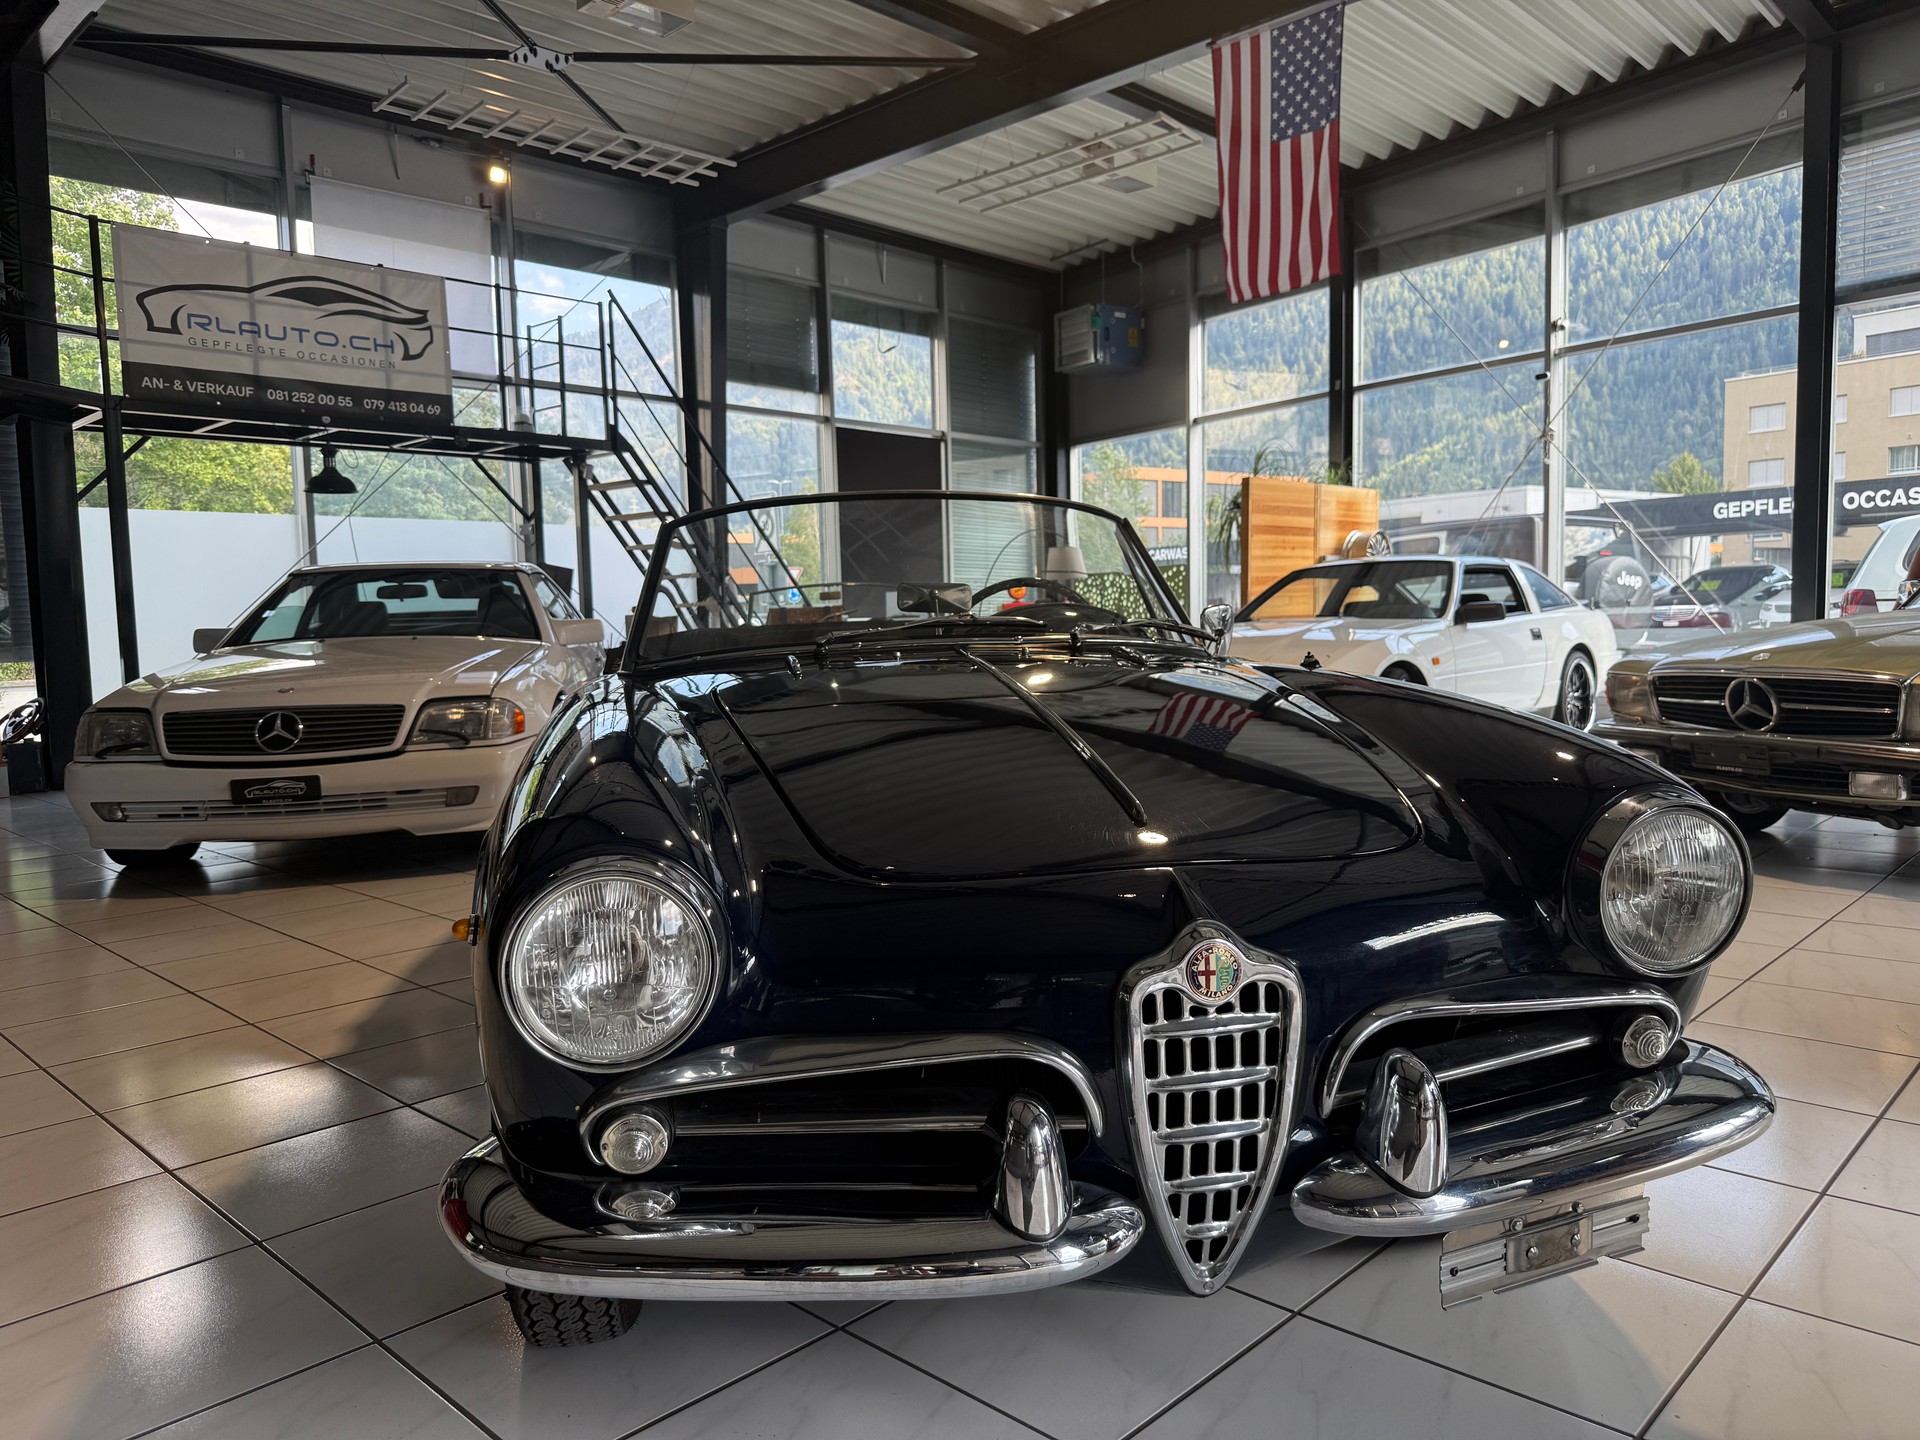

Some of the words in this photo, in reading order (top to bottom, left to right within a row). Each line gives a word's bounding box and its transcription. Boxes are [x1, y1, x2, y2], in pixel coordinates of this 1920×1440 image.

[187, 312, 395, 354] RLAUTO.CH
[188, 336, 286, 358] GEPFLEGTE
[296, 350, 396, 369] OCCASIONEN
[141, 376, 170, 389] AN-
[173, 379, 184, 392] &
[186, 380, 255, 398] VERKAUF
[266, 388, 289, 401] 081
[292, 391, 315, 404] 252
[317, 394, 335, 406] 00
[337, 395, 353, 408] 55
[363, 399, 385, 411] 079
[387, 401, 408, 413] 413
[409, 402, 425, 414] 04
[426, 404, 441, 416] 69
[1712, 496, 1795, 520] GEPFLE
[1617, 570, 1643, 590] Jeep
[1199, 985, 1233, 998] MILANO
